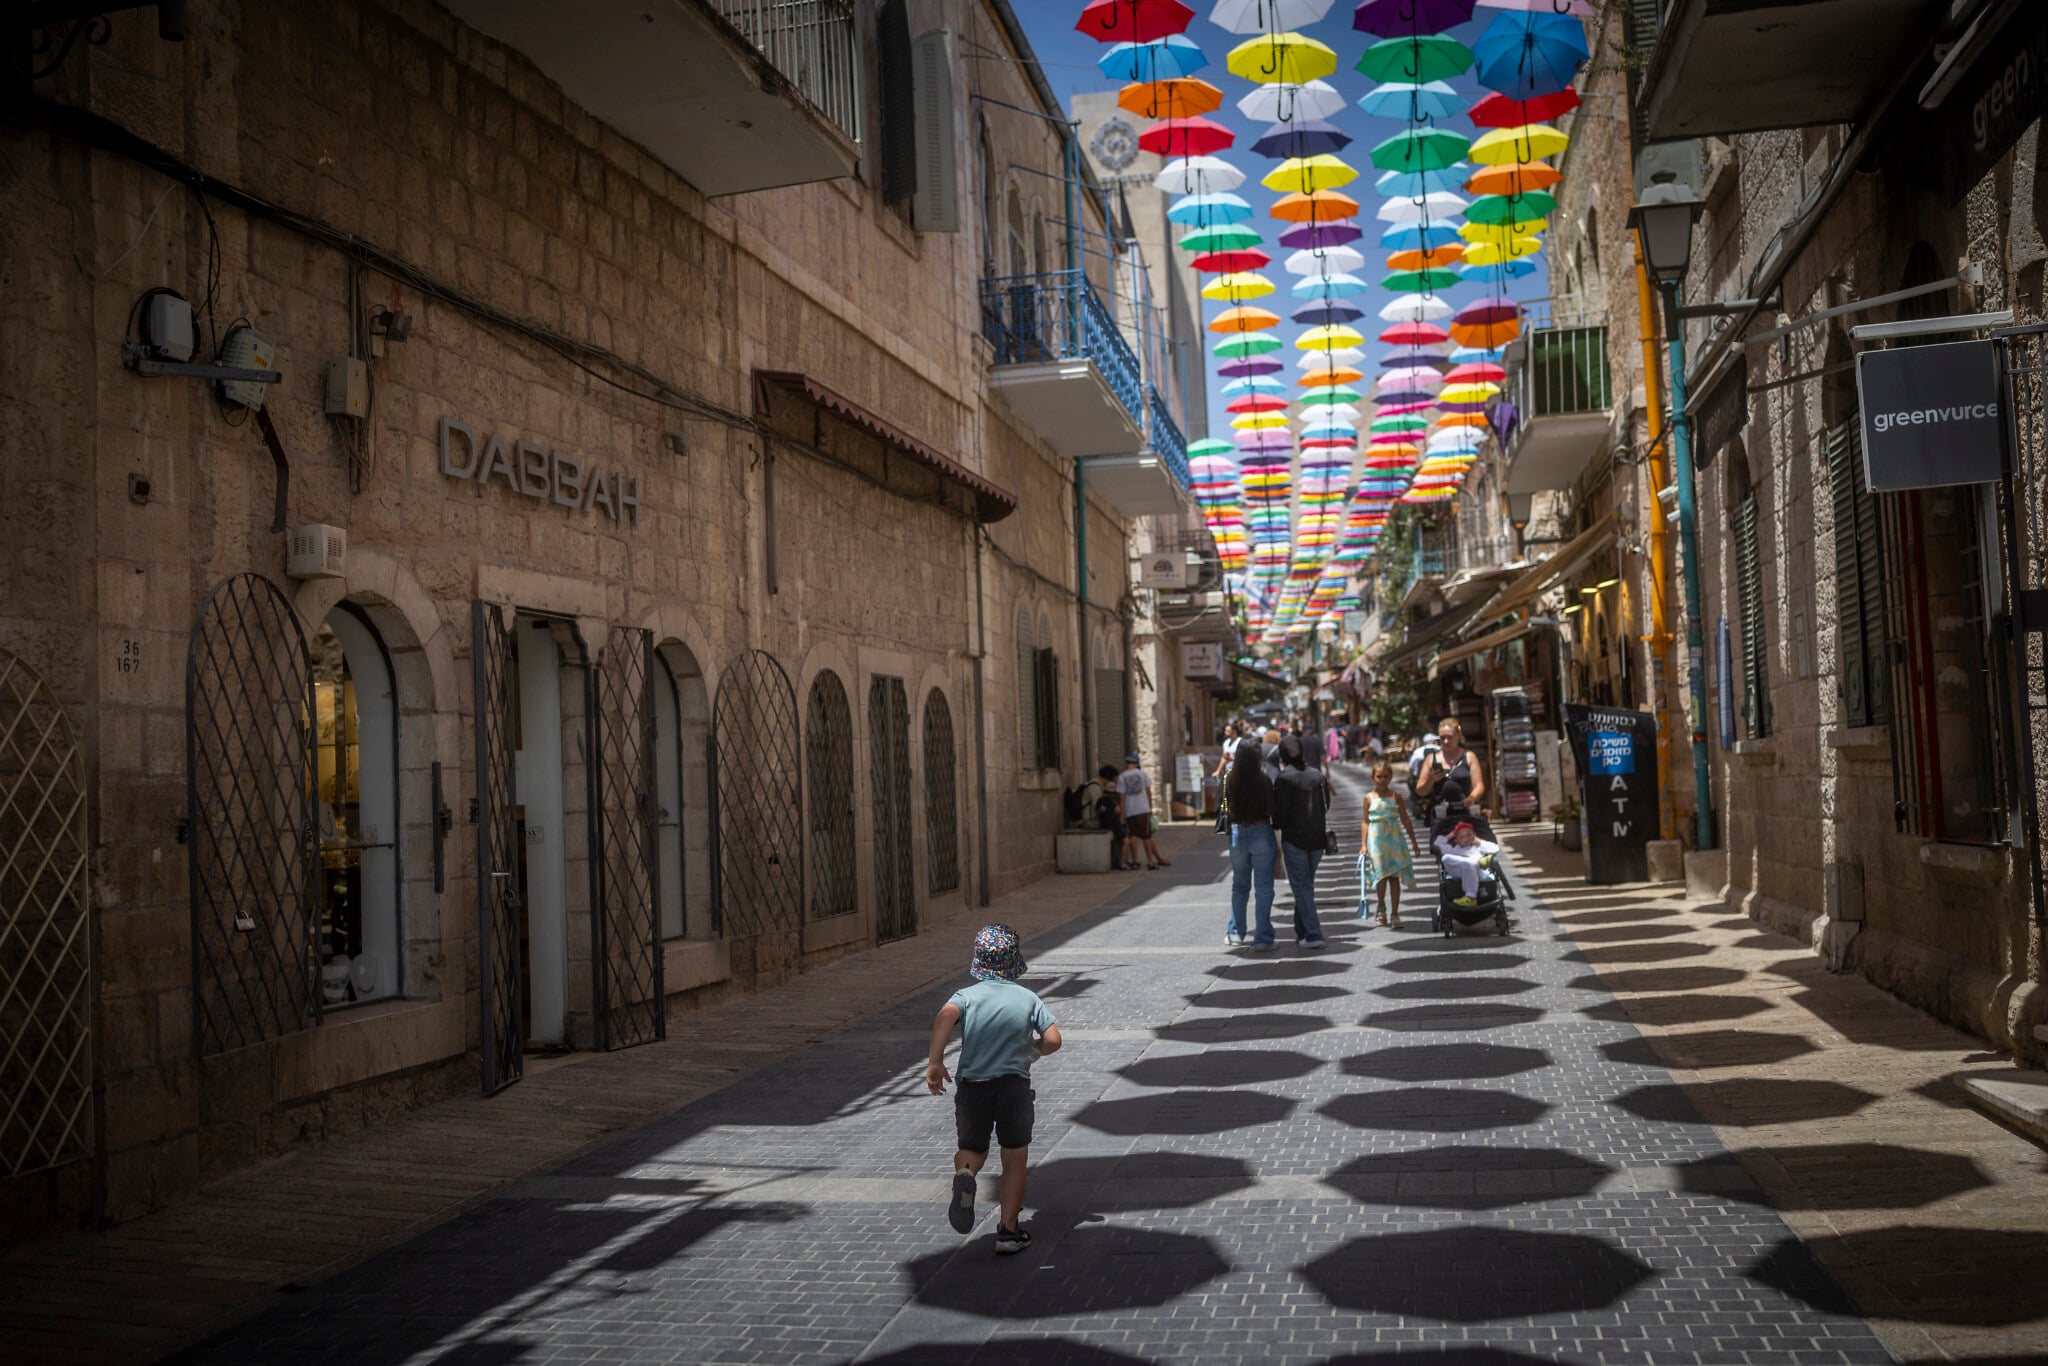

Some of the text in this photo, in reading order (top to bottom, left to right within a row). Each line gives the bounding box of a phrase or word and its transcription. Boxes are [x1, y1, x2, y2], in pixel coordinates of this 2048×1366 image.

[440, 416, 640, 529] DABBAH
[124, 640, 139, 656] 36
[117, 657, 140, 674] 167
[1593, 737, 1629, 748] משיכת
[1591, 747, 1631, 757] מזומנים
[1603, 757, 1621, 767] כאן
